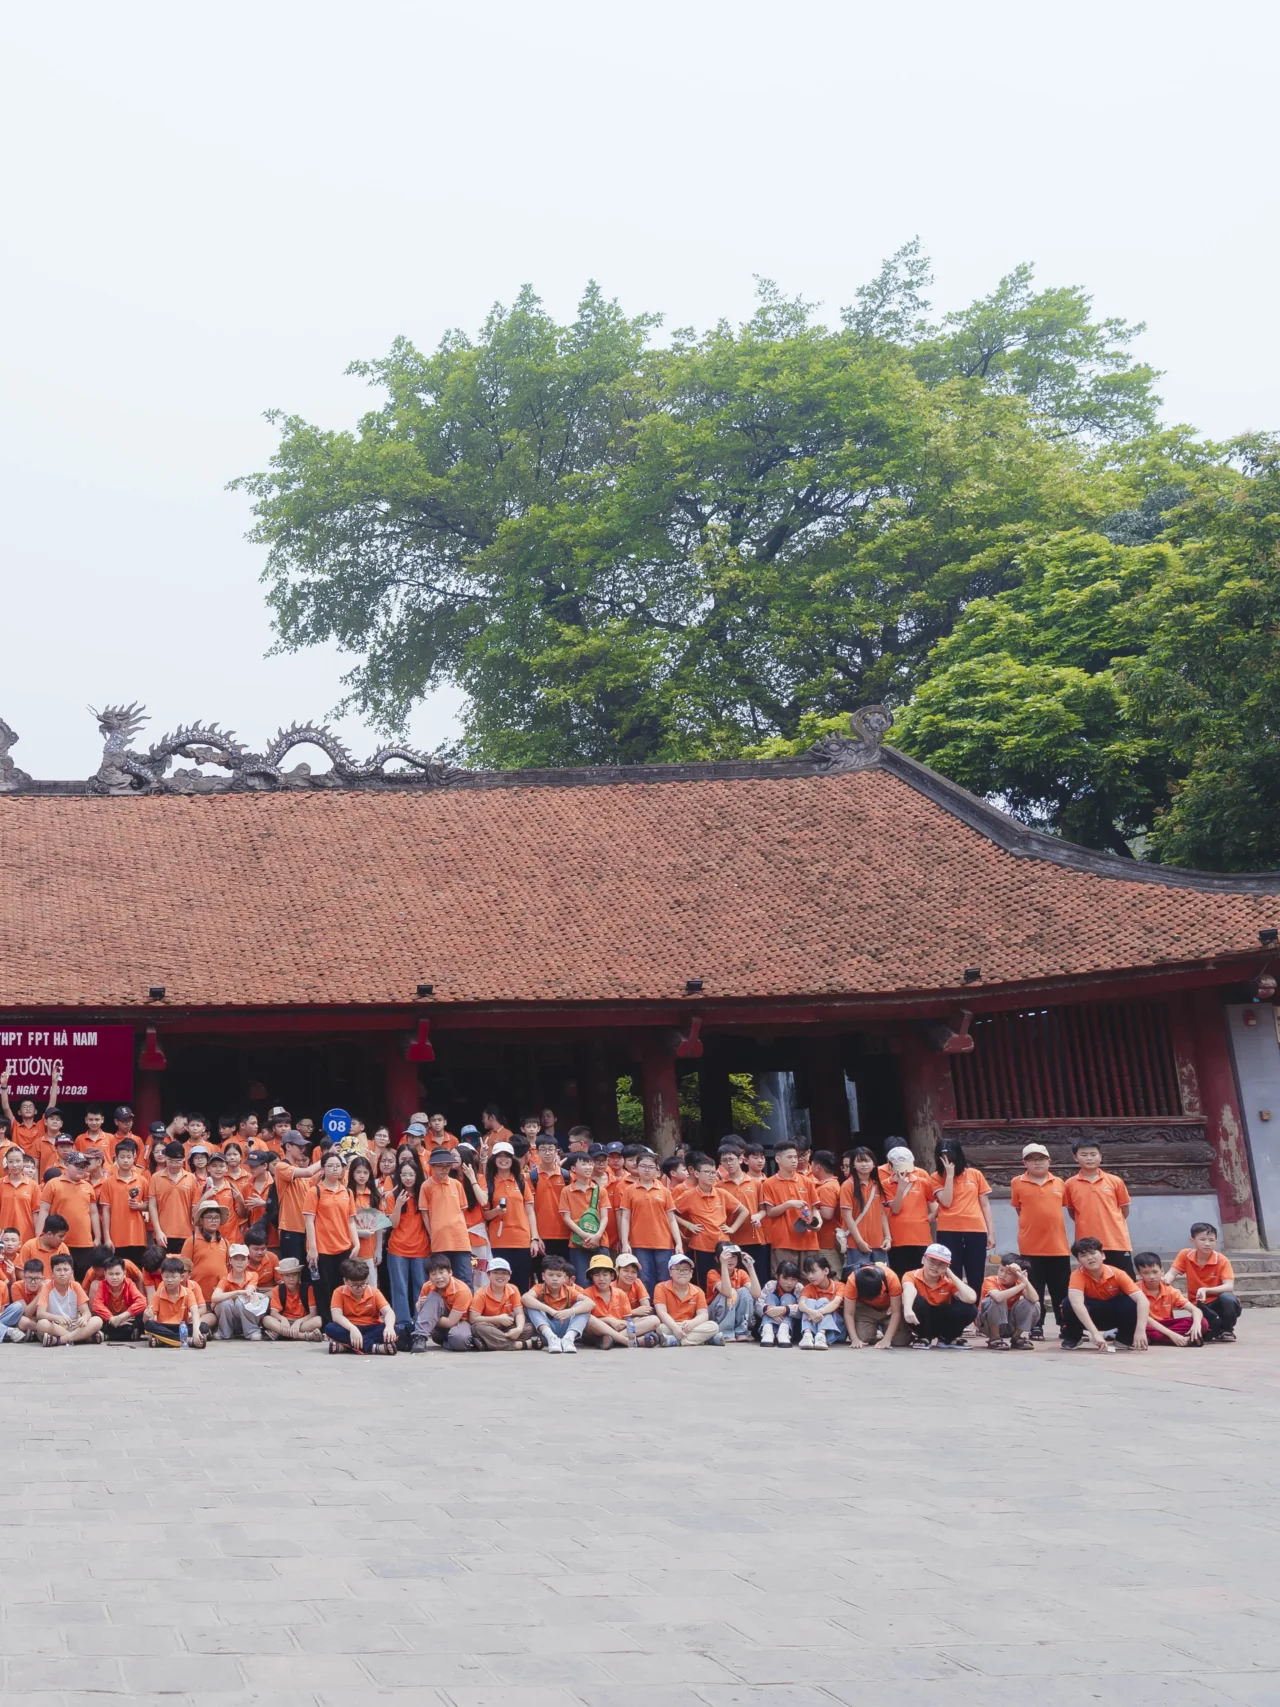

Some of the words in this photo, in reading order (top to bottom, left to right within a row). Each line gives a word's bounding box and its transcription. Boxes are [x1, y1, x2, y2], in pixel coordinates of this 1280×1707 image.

[28, 1032, 50, 1046] FPT
[53, 1029, 68, 1046] HÀ
[73, 1032, 98, 1046] NAM
[5, 1055, 65, 1077] HƯƠNG
[16, 1083, 40, 1095] NGÀY
[328, 1120, 346, 1132] 08
